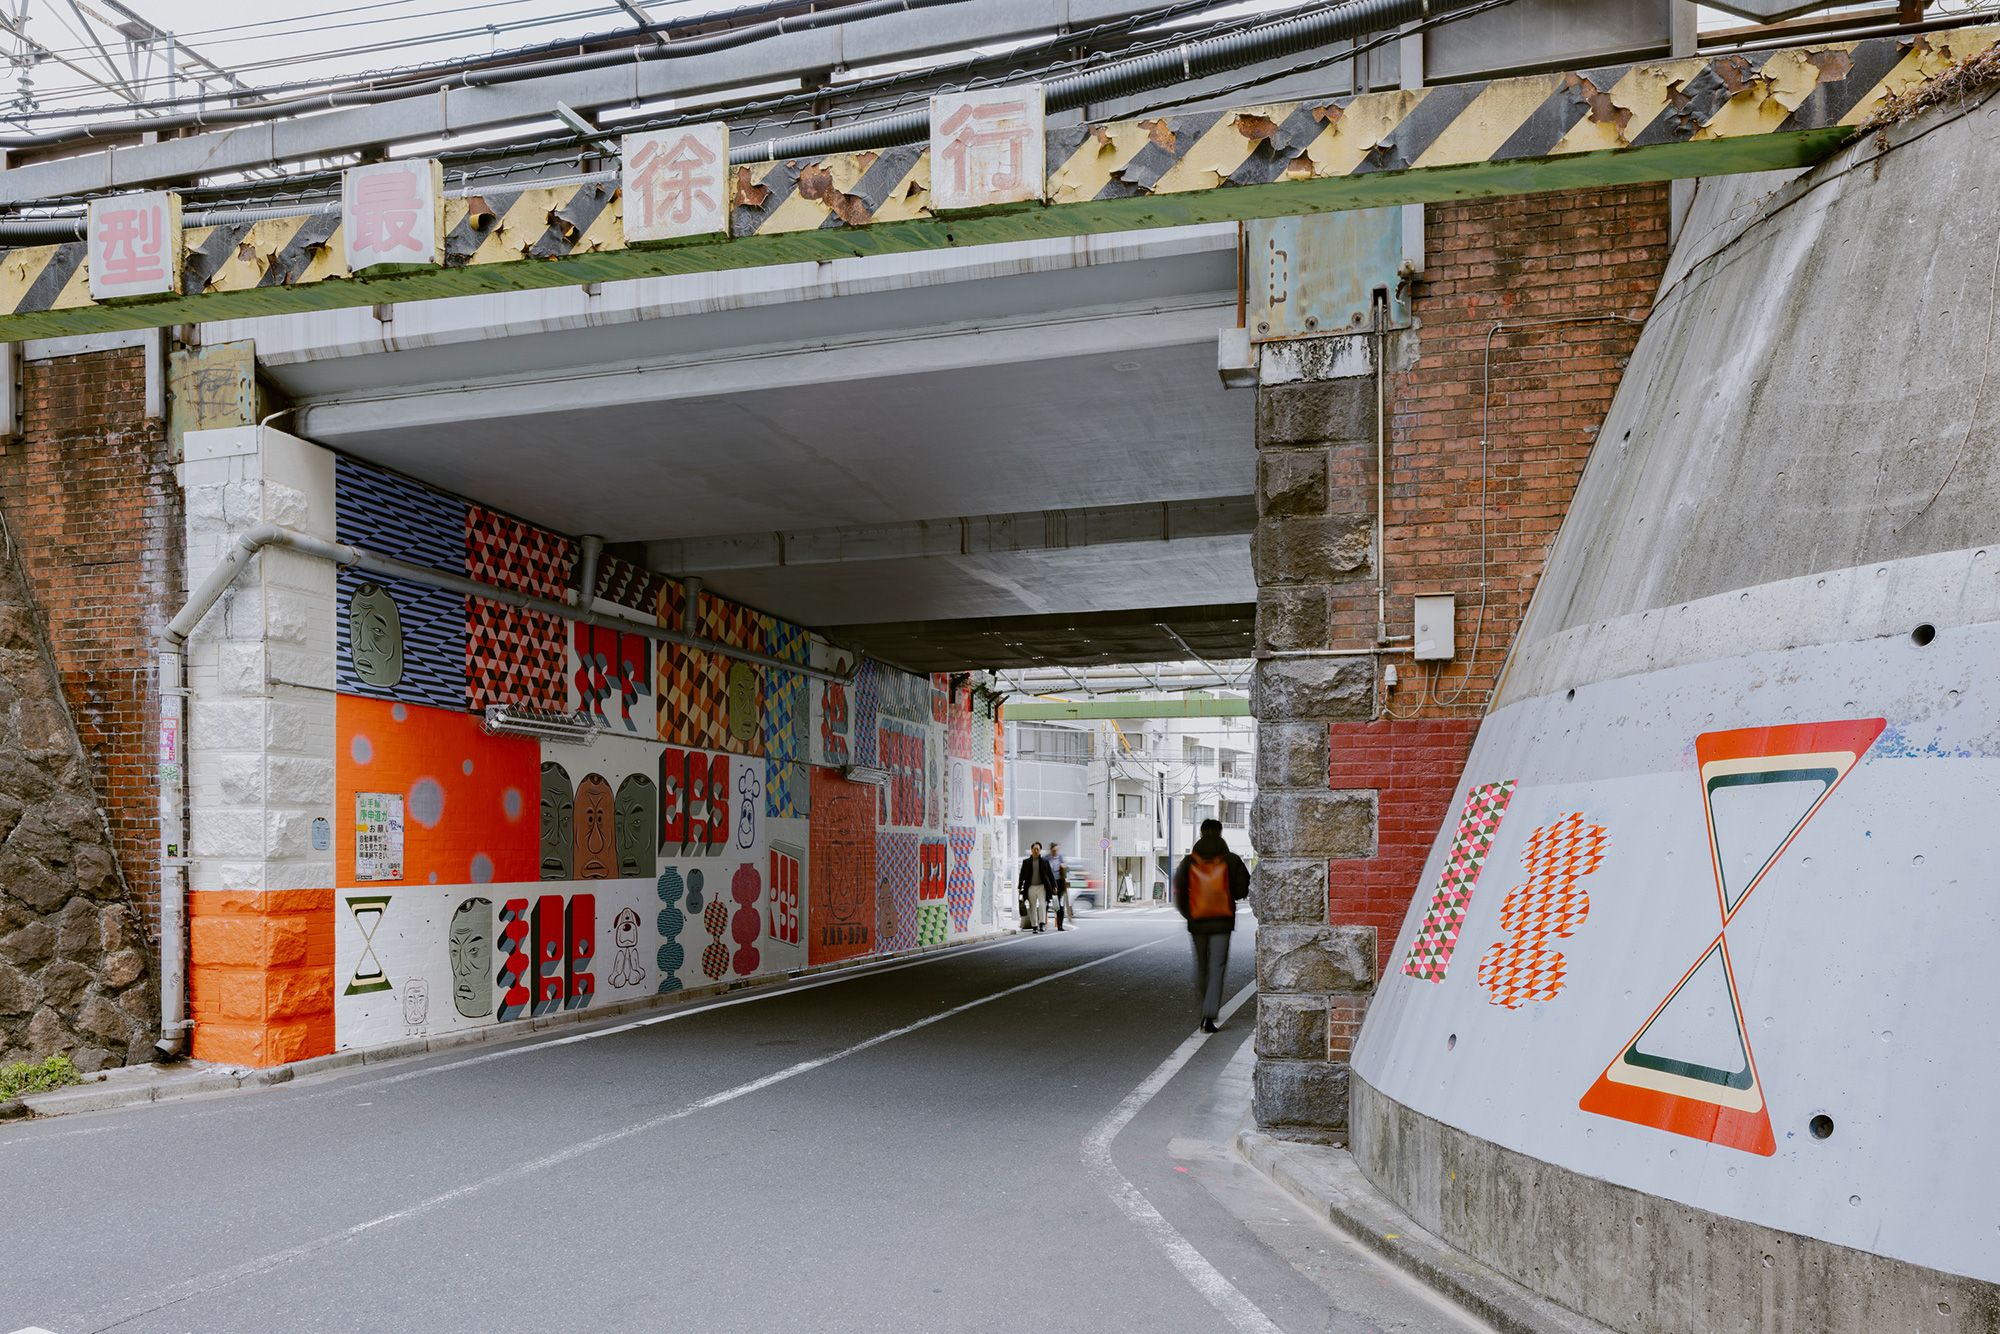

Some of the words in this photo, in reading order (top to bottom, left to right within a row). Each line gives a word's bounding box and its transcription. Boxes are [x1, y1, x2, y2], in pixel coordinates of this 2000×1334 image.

[99, 205, 164, 284] 型
[351, 171, 424, 251] 最
[630, 133, 716, 227] 徐
[939, 102, 1033, 193] 行
